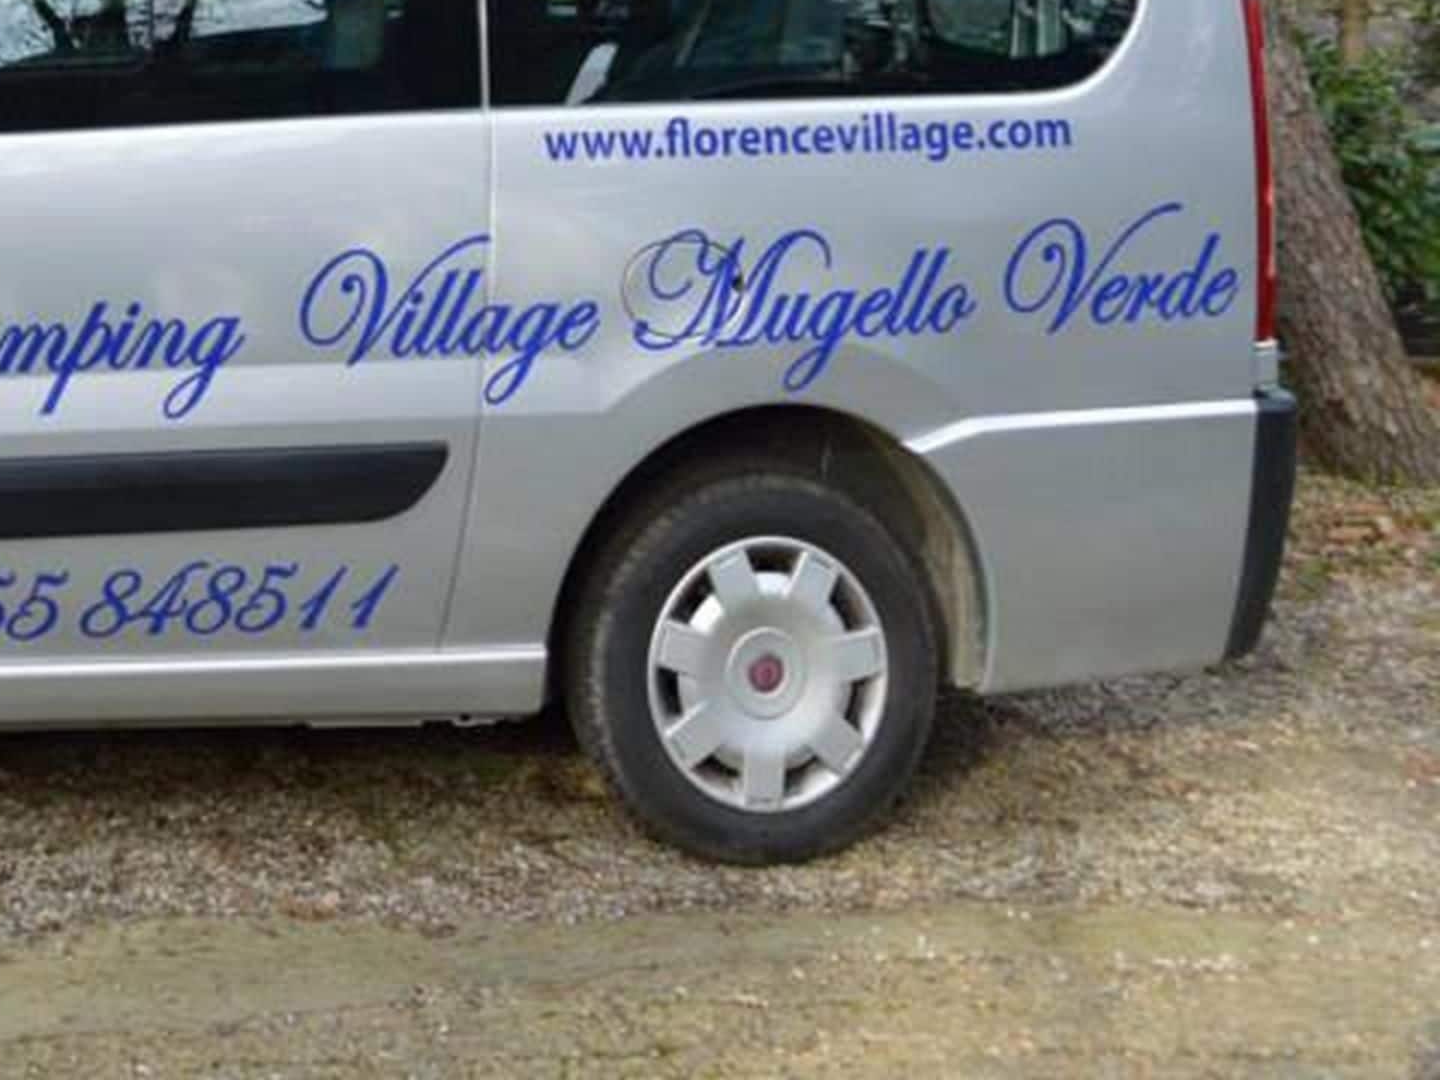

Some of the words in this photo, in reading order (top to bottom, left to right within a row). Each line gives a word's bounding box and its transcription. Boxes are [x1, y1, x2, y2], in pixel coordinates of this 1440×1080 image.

[545, 114, 1072, 164] www.florencevillage.com
[300, 235, 599, 404] Village
[634, 229, 975, 391] Mugello
[1003, 203, 1239, 334] Verde
[79, 560, 399, 638] 848511
